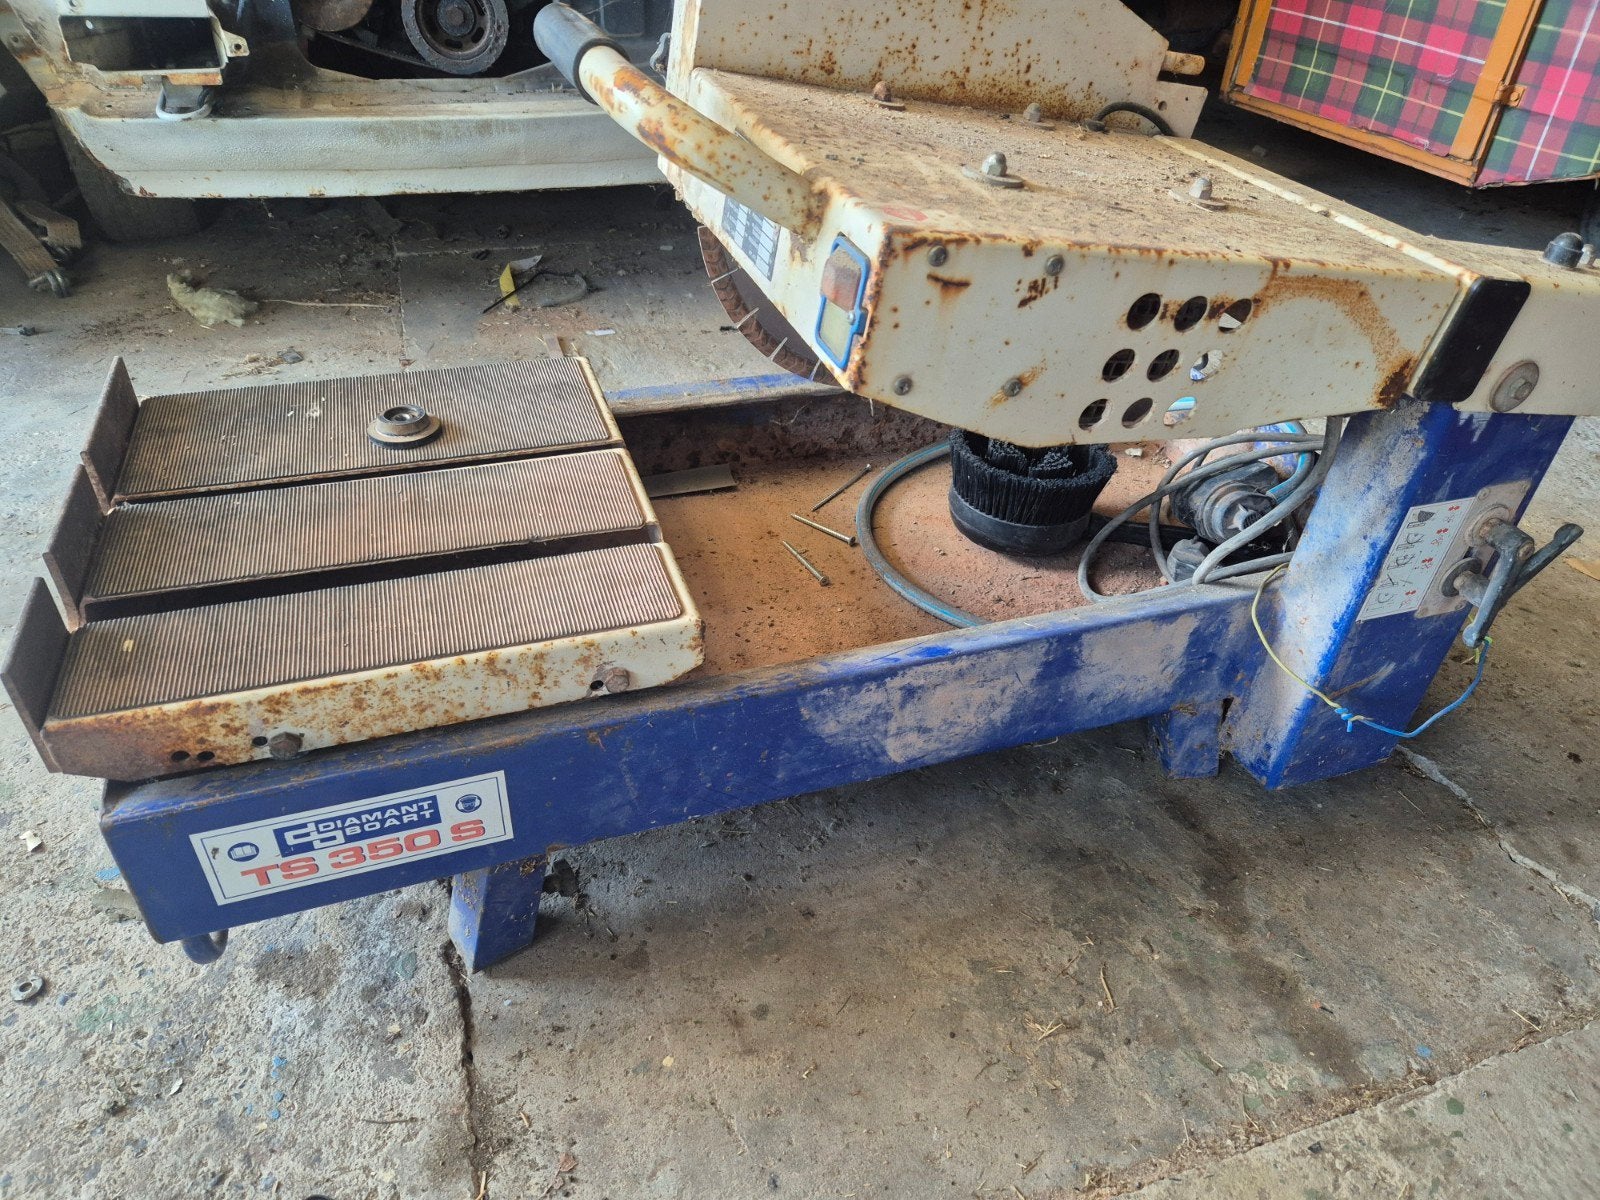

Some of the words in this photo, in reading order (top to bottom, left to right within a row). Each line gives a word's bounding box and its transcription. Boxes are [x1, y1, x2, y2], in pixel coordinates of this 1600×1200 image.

[319, 800, 433, 831] DIAMANT
[346, 809, 435, 836] BOART
[240, 856, 320, 886] TS
[328, 829, 442, 869] 350
[450, 819, 486, 842] S
